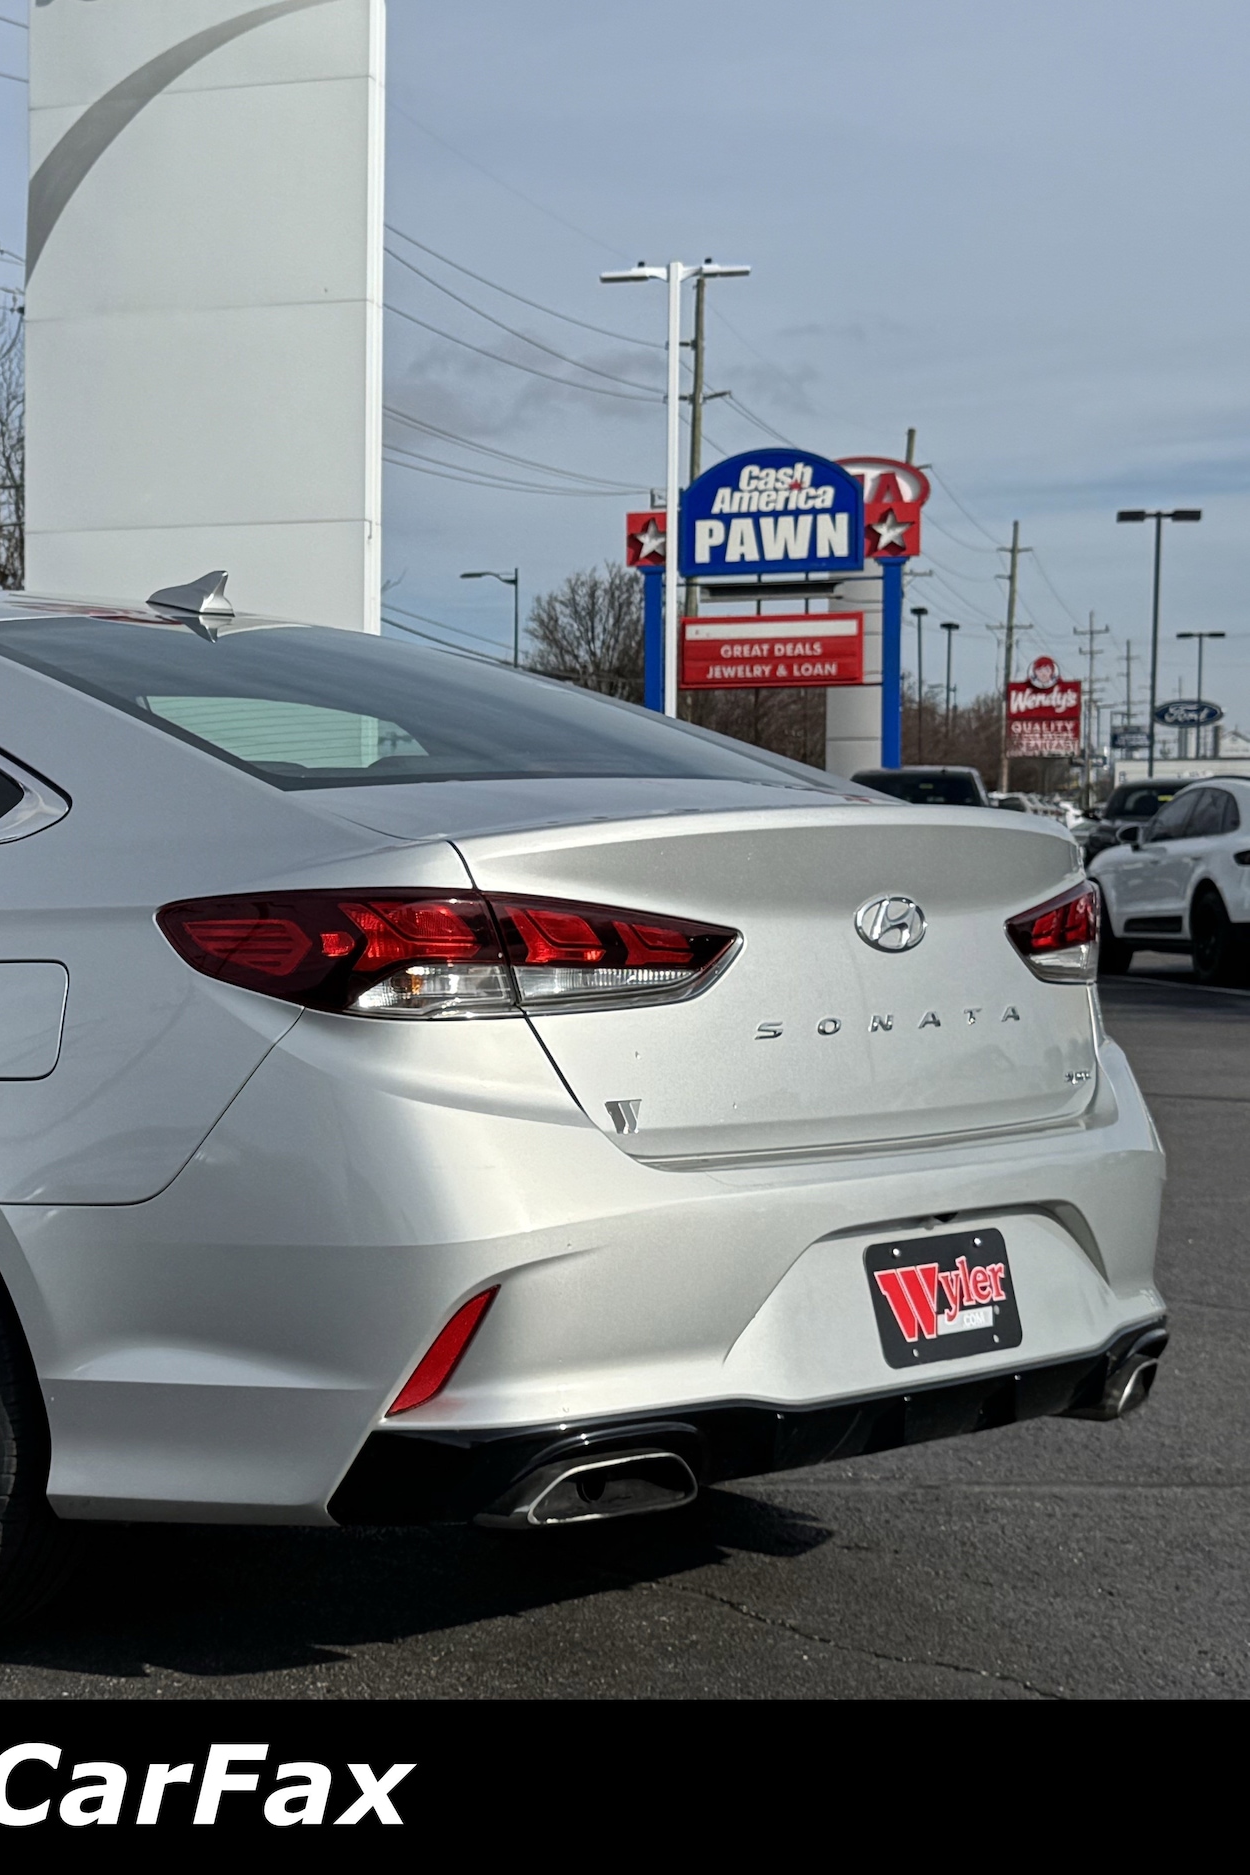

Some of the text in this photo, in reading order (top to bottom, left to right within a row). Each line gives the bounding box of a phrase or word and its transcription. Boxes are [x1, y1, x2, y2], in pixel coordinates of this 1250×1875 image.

[739, 461, 813, 492] Cash
[711, 485, 835, 514] America
[695, 512, 849, 563] PAWN
[720, 641, 823, 658] GREAT DEALS
[706, 662, 838, 679] JEWELRY & LOAN
[1010, 685, 1078, 714] Wendy's
[1011, 720, 1075, 734] QUALITY
[755, 1005, 1021, 1041] SONATA
[874, 1255, 1006, 1342] Wyler
